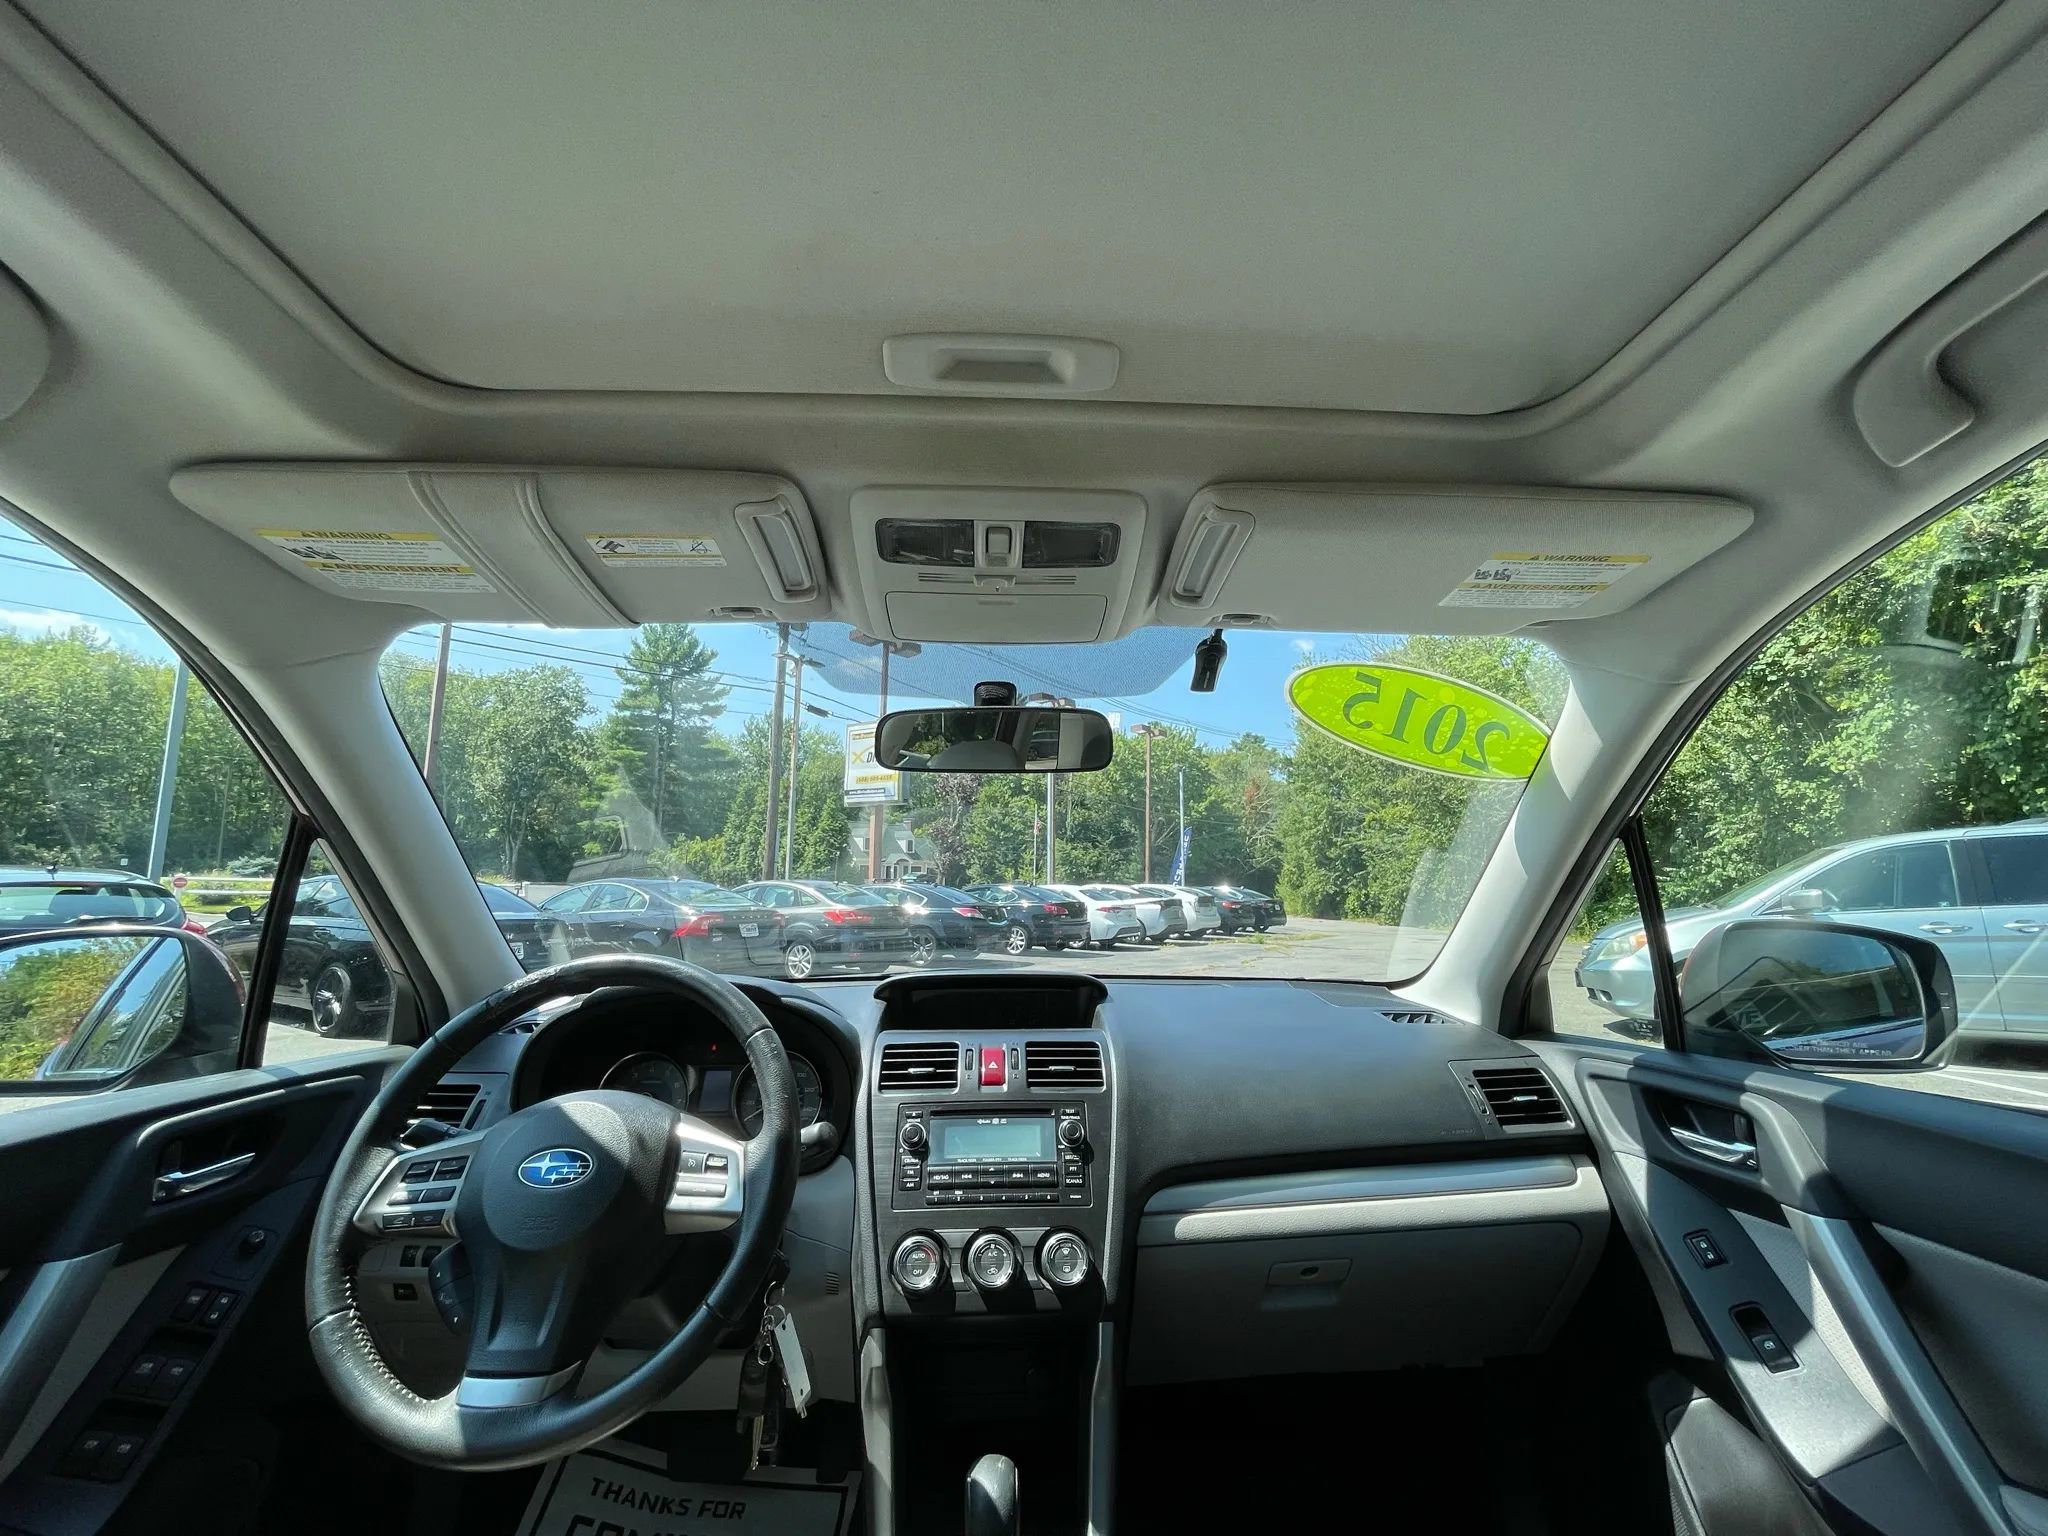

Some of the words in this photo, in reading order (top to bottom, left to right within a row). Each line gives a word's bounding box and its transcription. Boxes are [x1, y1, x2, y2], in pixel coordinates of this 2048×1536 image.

[314, 531, 392, 540] WARNING
[1859, 1049, 1892, 1057] APPEAR
[591, 1477, 693, 1516] THANKS
[697, 1500, 747, 1519] FOR
